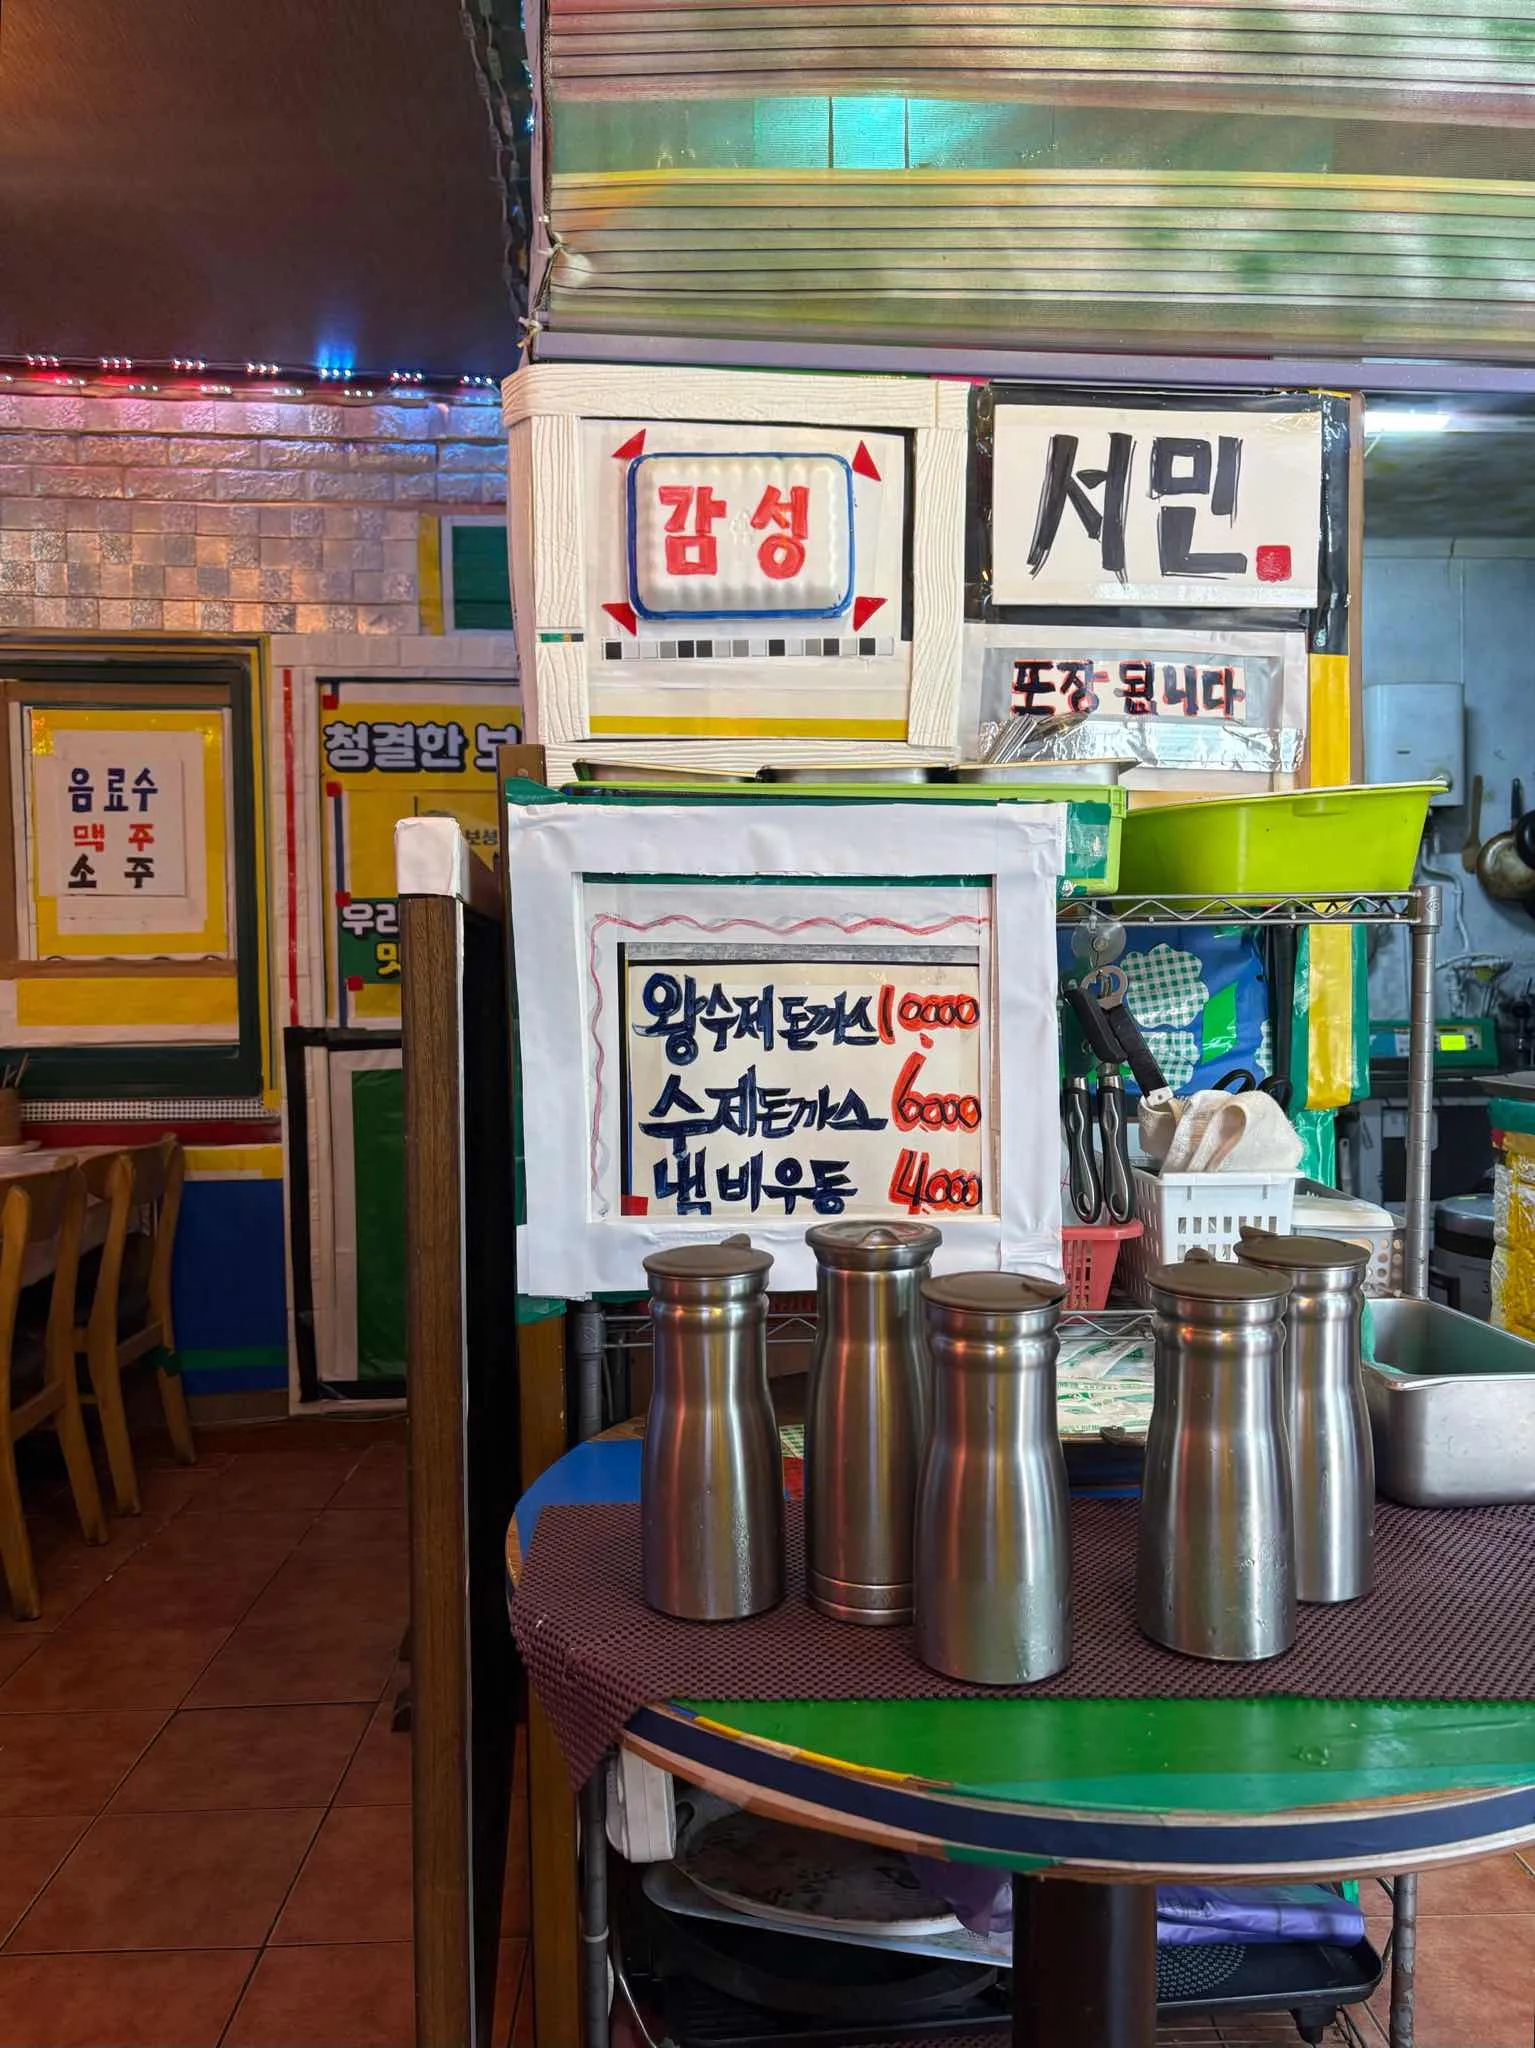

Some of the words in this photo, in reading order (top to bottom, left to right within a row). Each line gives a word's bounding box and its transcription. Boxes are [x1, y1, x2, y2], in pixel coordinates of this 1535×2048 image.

[658, 484, 810, 580] 감성
[1026, 432, 1248, 592] 서민
[1010, 658, 1111, 716] 포장
[1112, 658, 1246, 720] 됩니다
[323, 721, 468, 773] 청결한
[67, 767, 159, 813] 음료수
[638, 1064, 889, 1160] 수제돈까스
